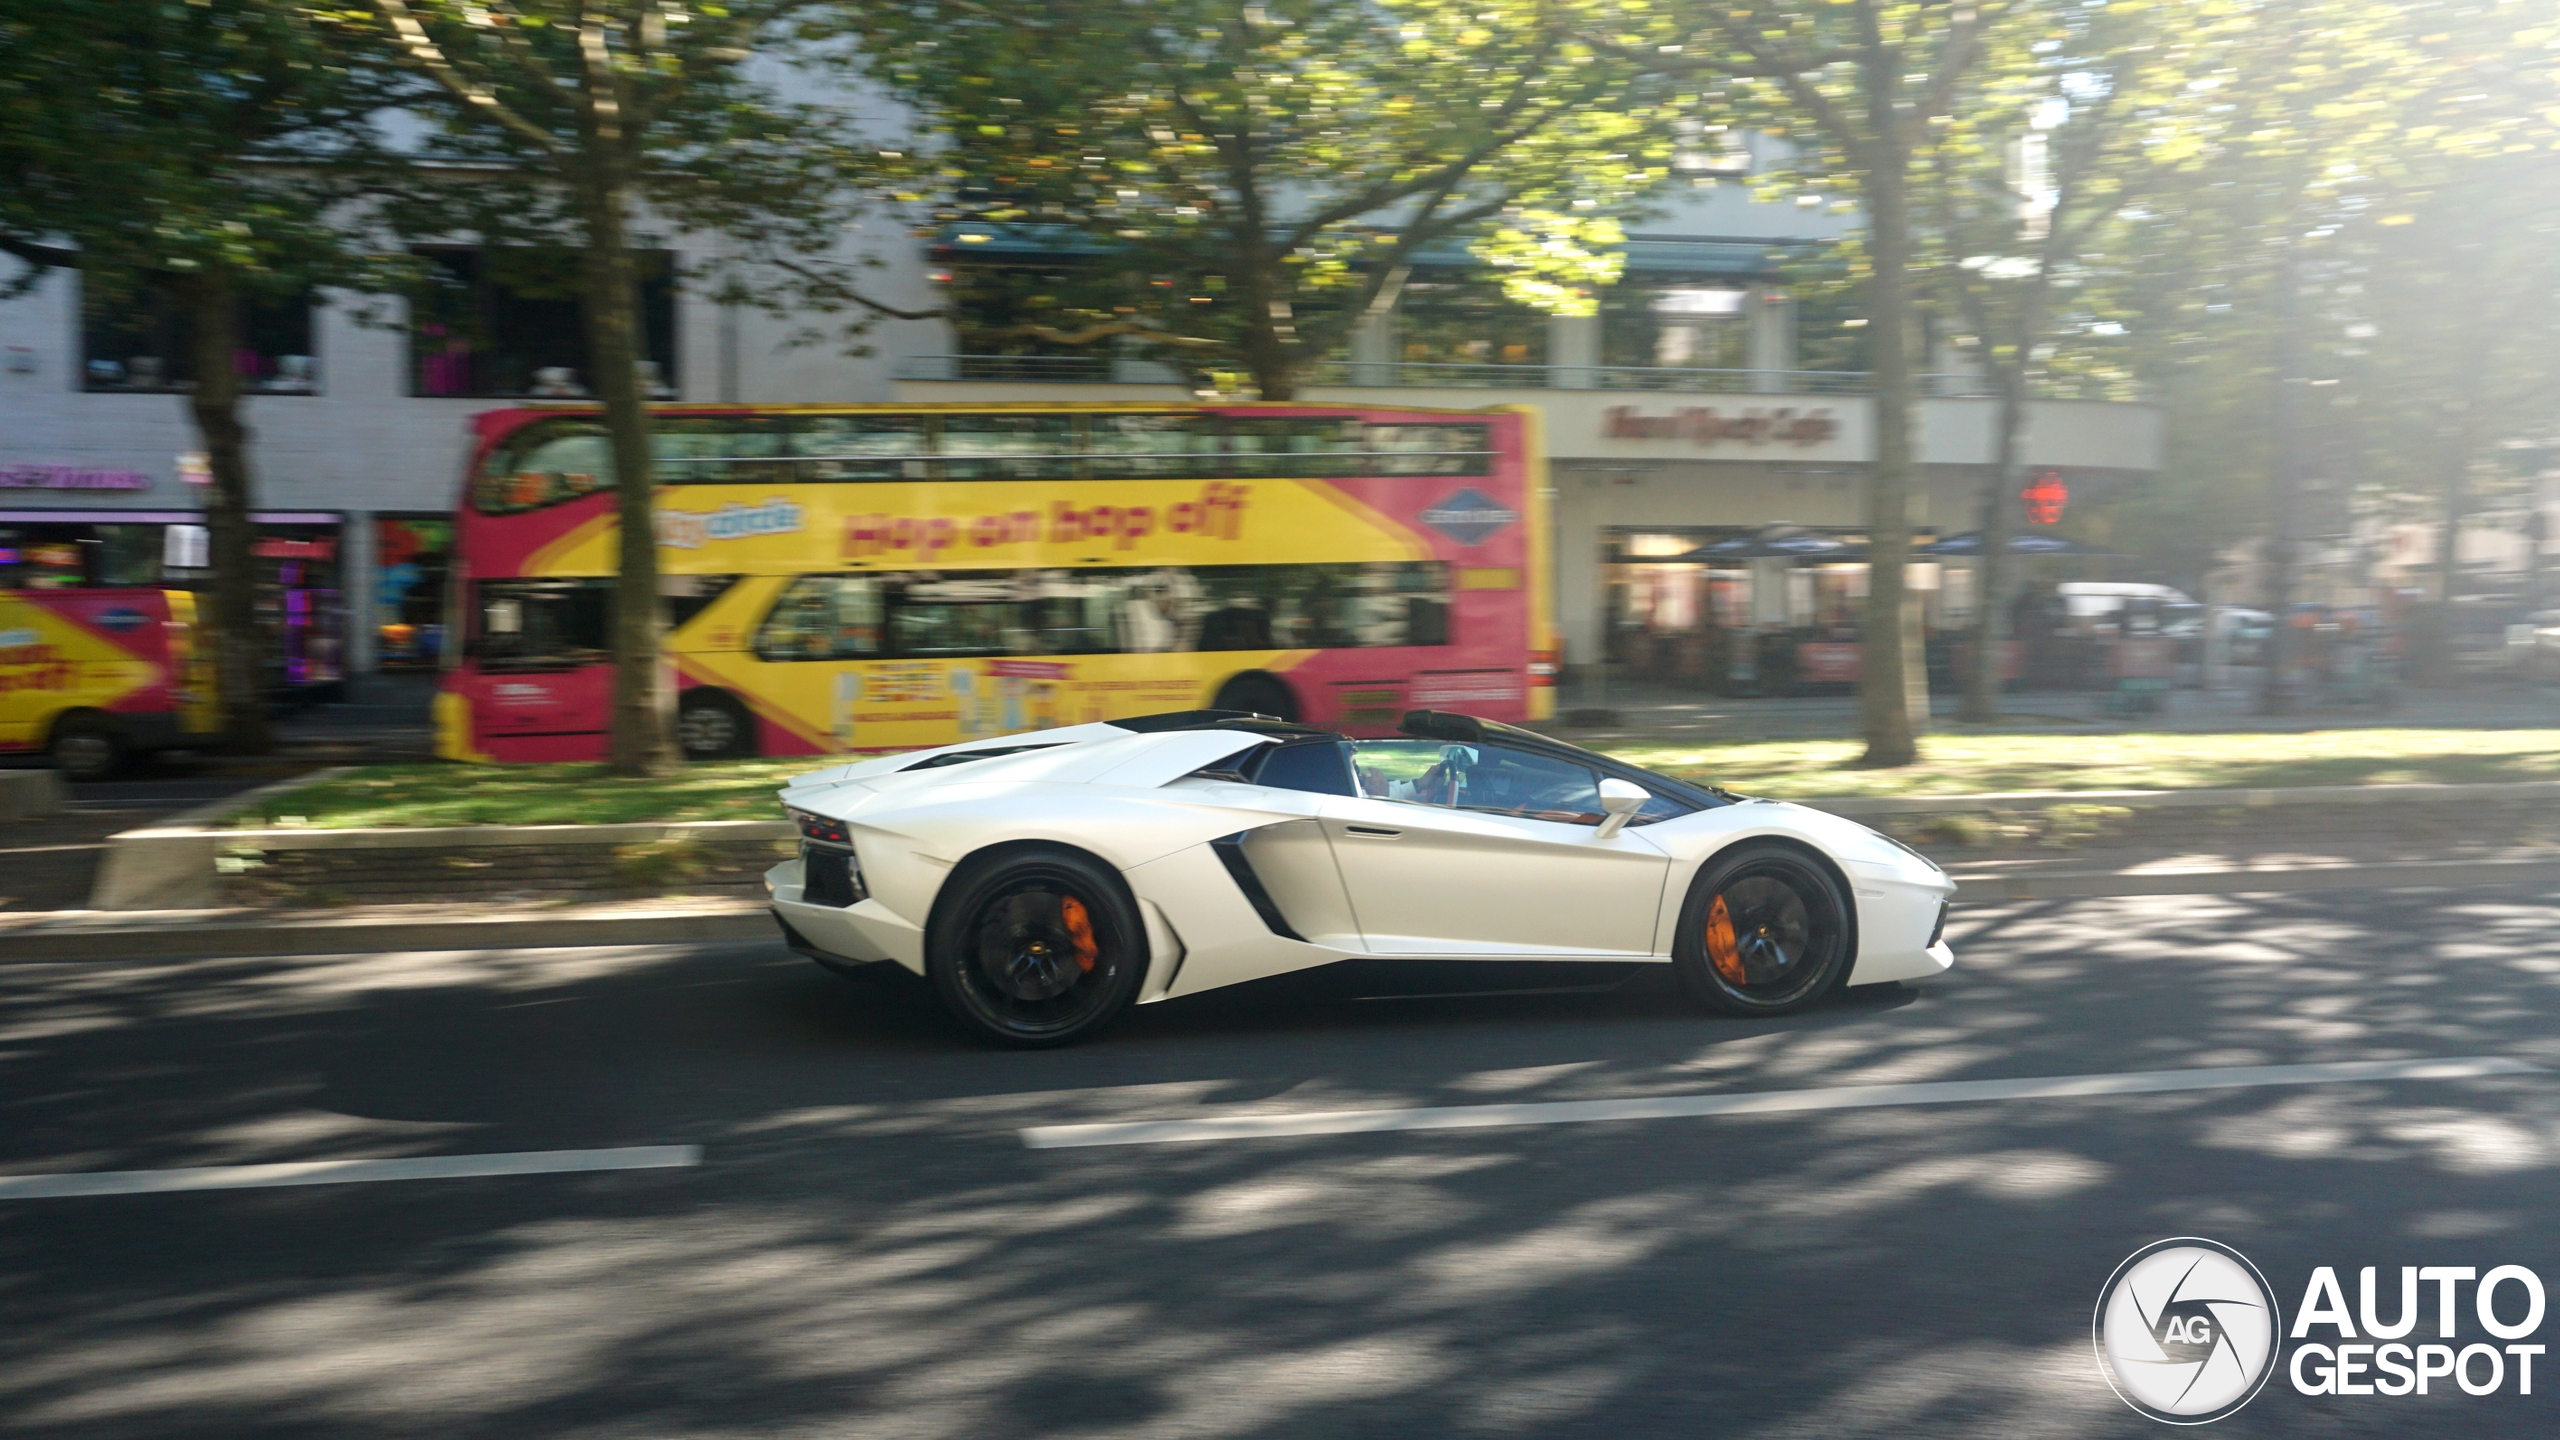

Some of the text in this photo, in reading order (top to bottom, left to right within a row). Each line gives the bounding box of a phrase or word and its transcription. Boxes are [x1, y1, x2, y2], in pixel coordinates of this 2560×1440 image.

[840, 481, 1252, 562] Hop on hop off
